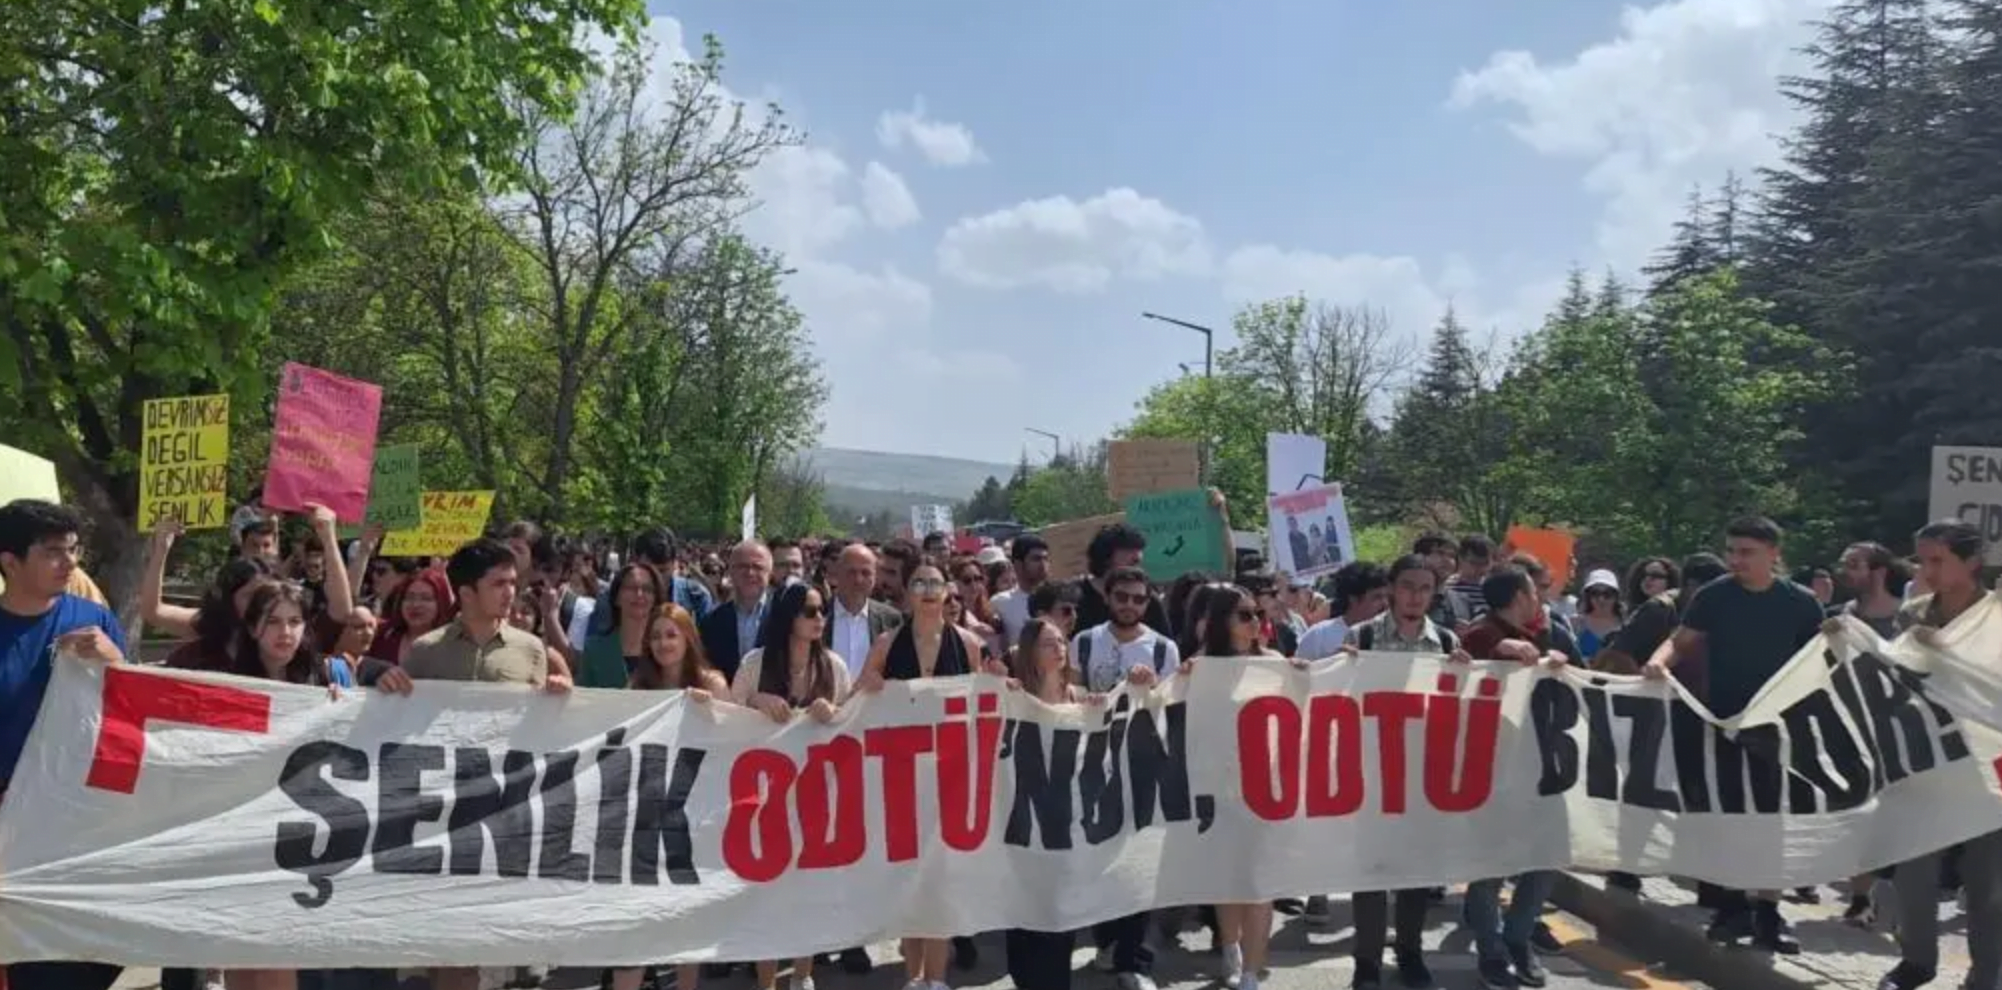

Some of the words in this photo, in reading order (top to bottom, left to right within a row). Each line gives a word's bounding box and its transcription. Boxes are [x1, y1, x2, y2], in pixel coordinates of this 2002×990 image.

[274, 727, 707, 908] ŞENLİK
[722, 692, 1215, 883] ODTÜ'NÜN,
[1237, 673, 1501, 821] ODTÜ
